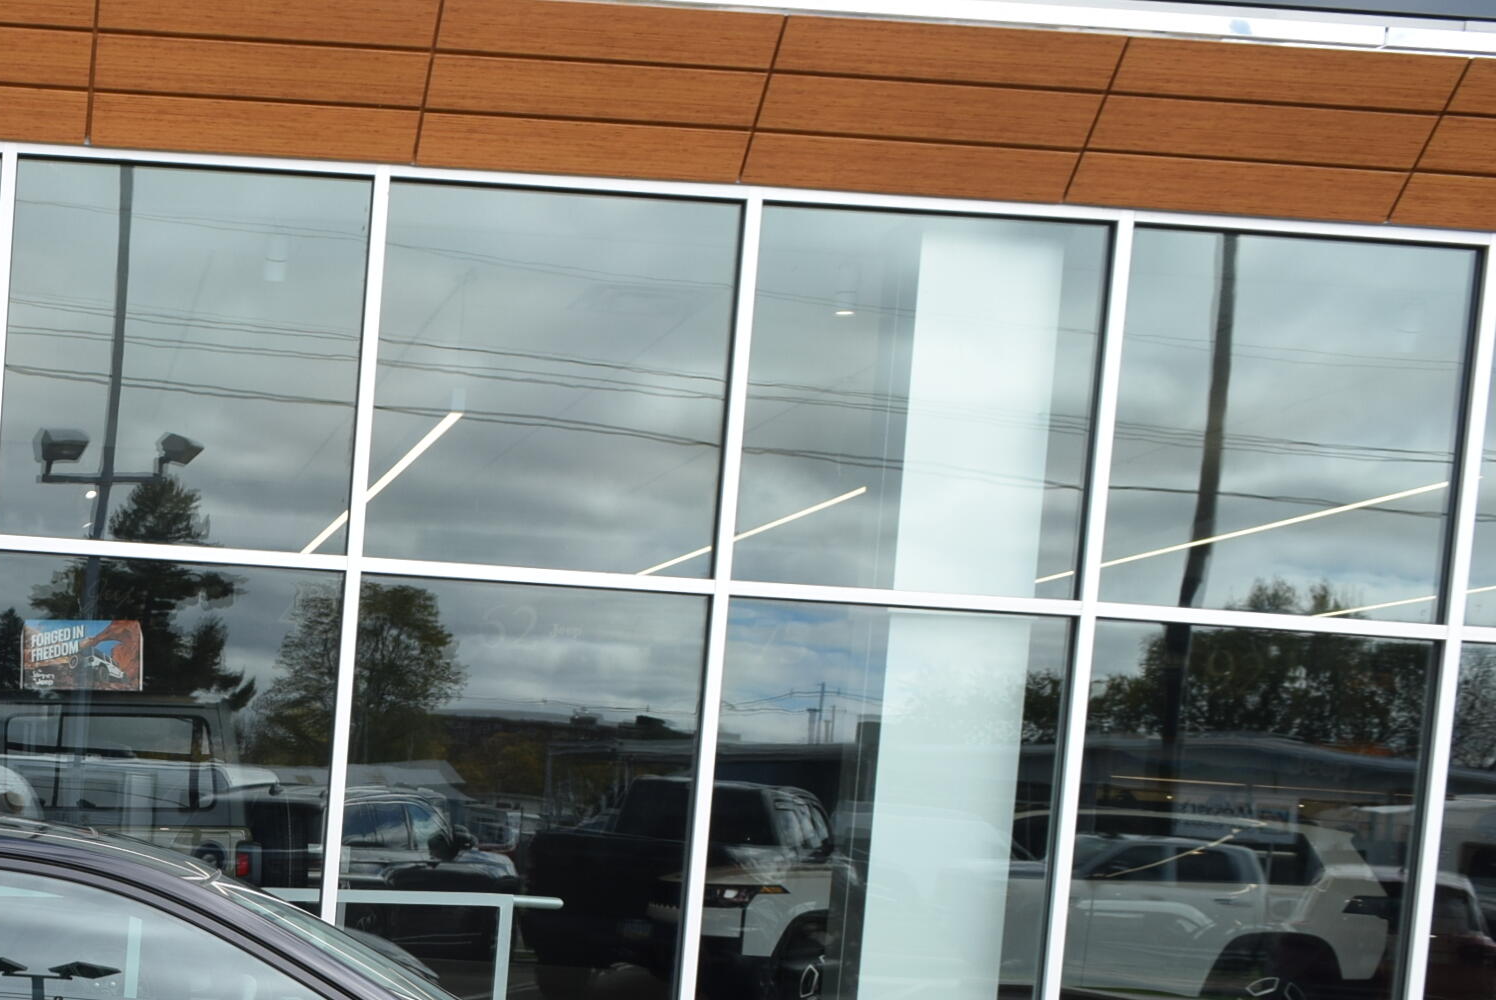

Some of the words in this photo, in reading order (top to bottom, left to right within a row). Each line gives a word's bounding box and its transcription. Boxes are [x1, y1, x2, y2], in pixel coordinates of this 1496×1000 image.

[31, 628, 71, 648] FORGED
[72, 626, 84, 639] IN
[31, 640, 79, 663] FREEDOM
